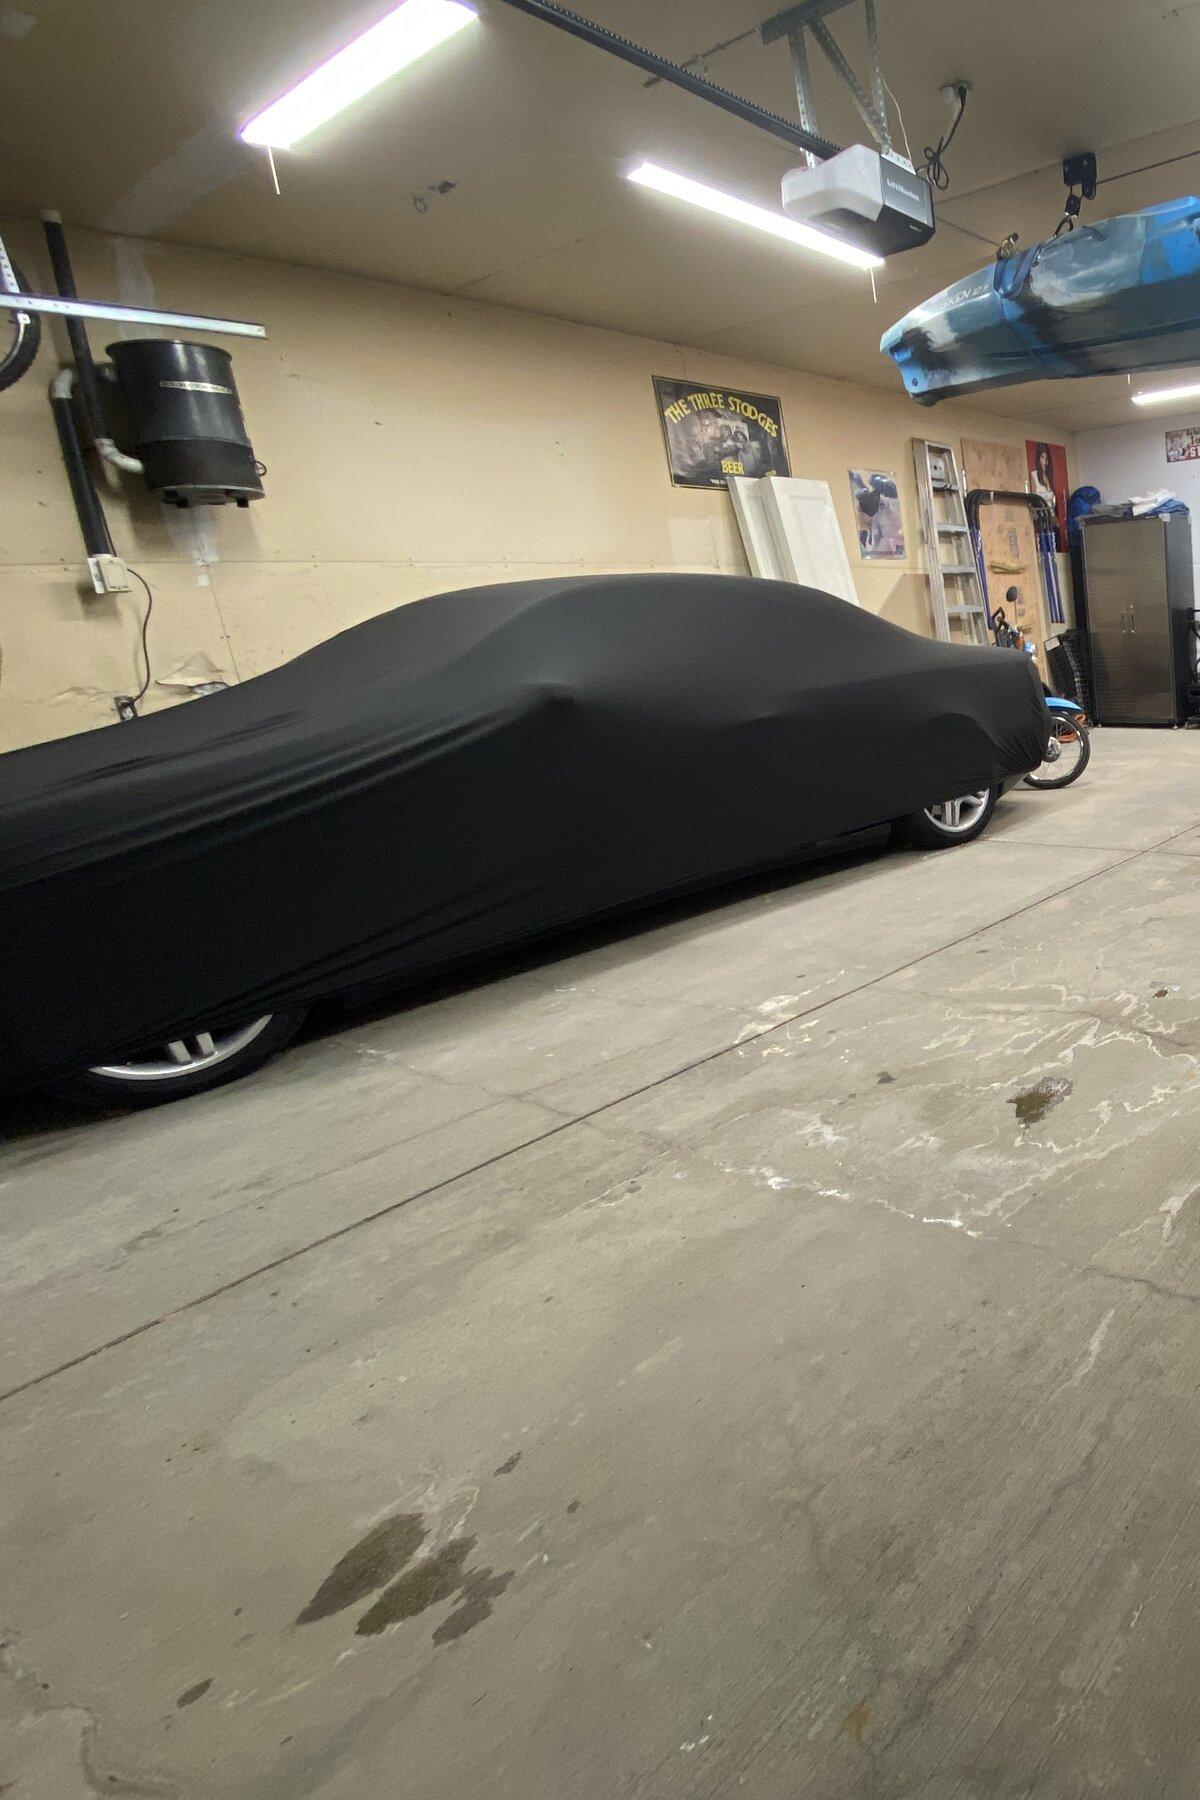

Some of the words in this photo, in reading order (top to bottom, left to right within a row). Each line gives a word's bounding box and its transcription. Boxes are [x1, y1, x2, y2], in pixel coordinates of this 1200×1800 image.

[664, 399, 691, 424] THE
[687, 392, 726, 411] THREE
[727, 397, 779, 437] STOOGES
[721, 460, 744, 475] BEER
